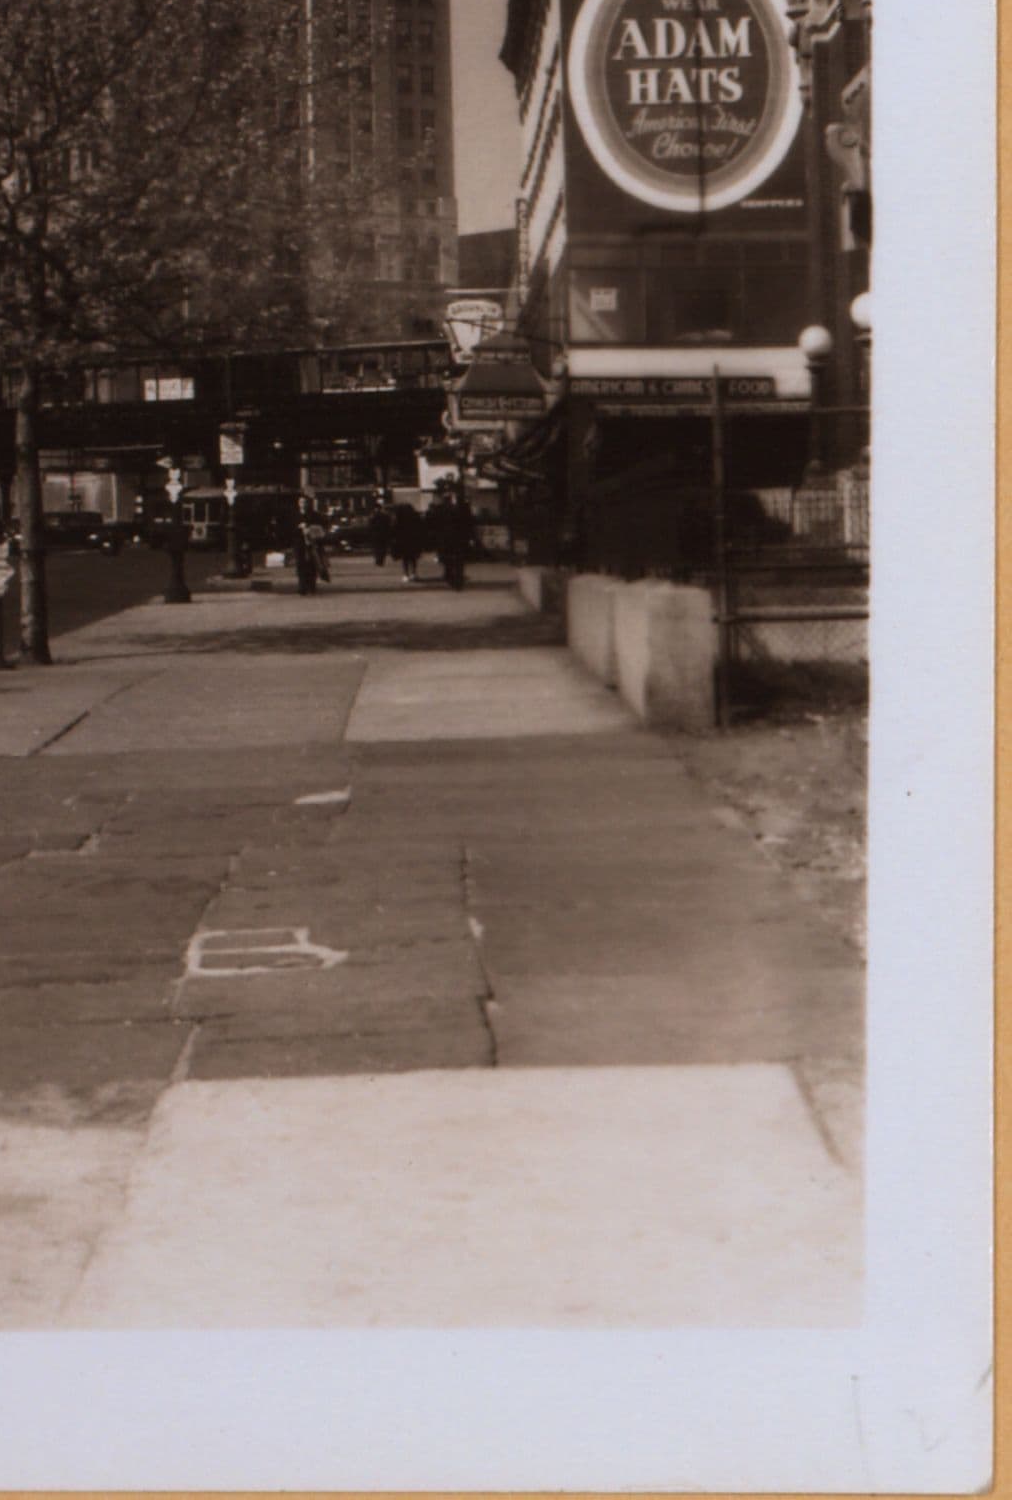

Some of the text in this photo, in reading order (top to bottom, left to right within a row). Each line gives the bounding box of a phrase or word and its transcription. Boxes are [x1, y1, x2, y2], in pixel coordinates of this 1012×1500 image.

[612, 16, 753, 60] ADAM
[625, 65, 744, 105] HATS
[662, 379, 717, 396] CHINES
[727, 379, 774, 396] FOOD
